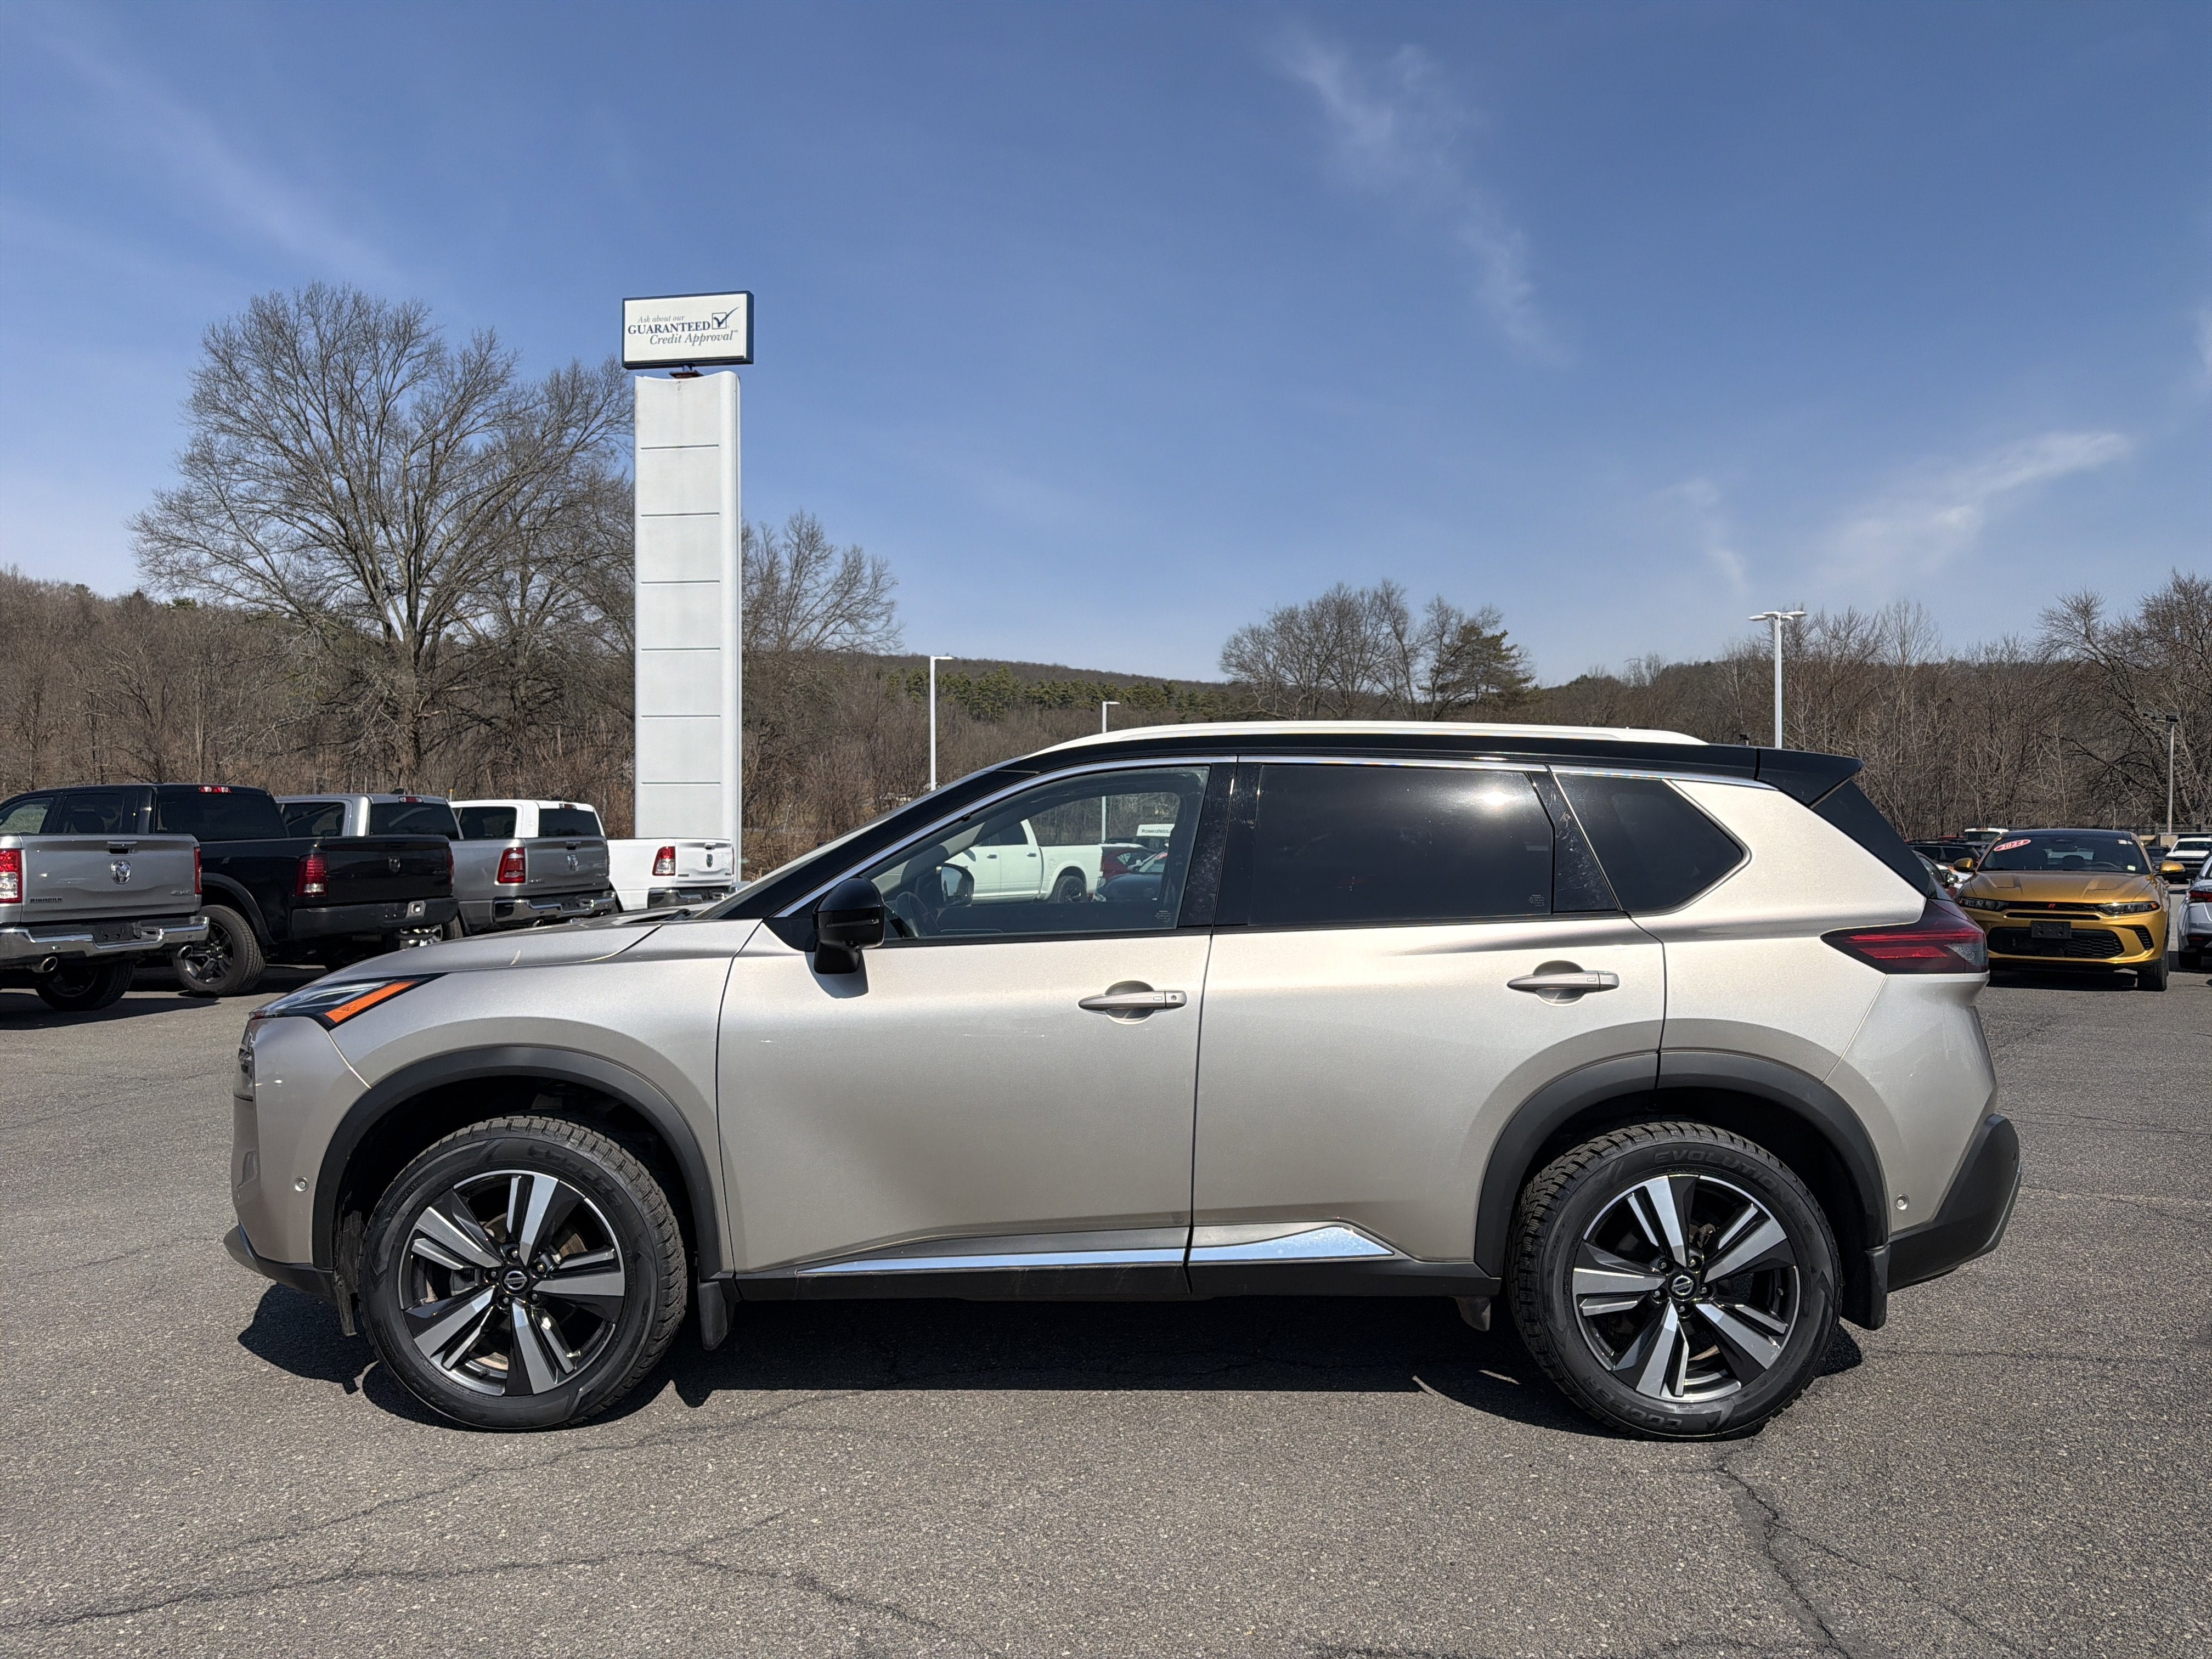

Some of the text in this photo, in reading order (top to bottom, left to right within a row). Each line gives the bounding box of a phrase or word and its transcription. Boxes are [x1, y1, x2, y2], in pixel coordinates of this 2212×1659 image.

[628, 321, 711, 335] GUARANTEED
[650, 330, 734, 346] Credit Approval
